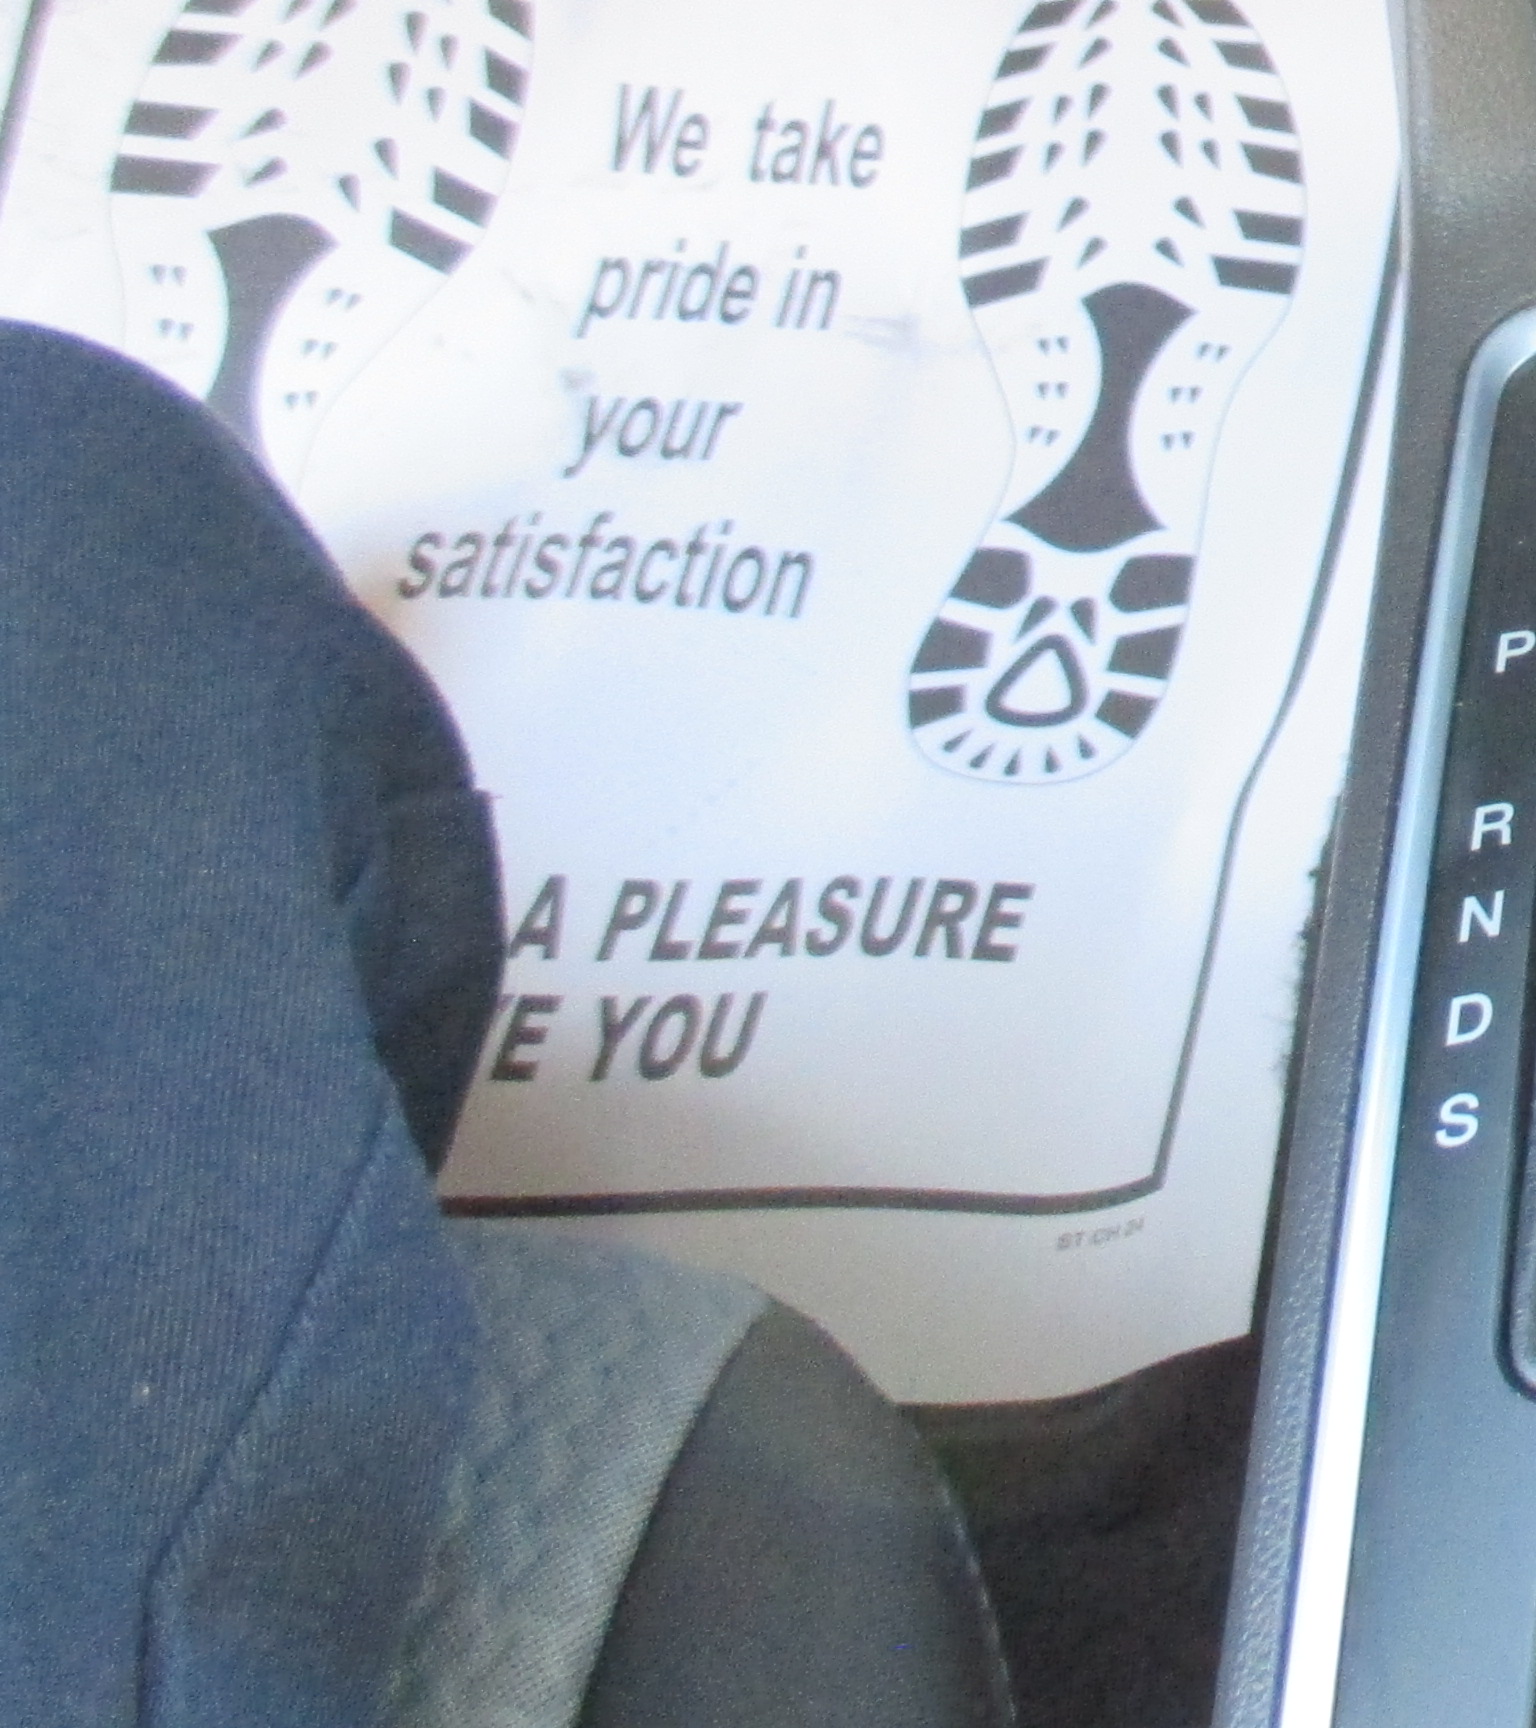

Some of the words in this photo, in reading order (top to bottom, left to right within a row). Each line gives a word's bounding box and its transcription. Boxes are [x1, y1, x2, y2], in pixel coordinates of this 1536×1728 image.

[608, 83, 709, 178] We
[747, 97, 886, 189] take
[571, 238, 757, 340] pride
[773, 245, 843, 329] in
[561, 383, 742, 476] your
[398, 510, 815, 619] satisfaction
[1494, 629, 1536, 674] P
[1469, 802, 1515, 851] R
[508, 872, 568, 961] A
[596, 874, 1036, 963] PLEASURE
[1457, 889, 1505, 944] N
[588, 990, 768, 1083] YOU
[1445, 991, 1494, 1047] D
[1434, 1092, 1480, 1149] S
